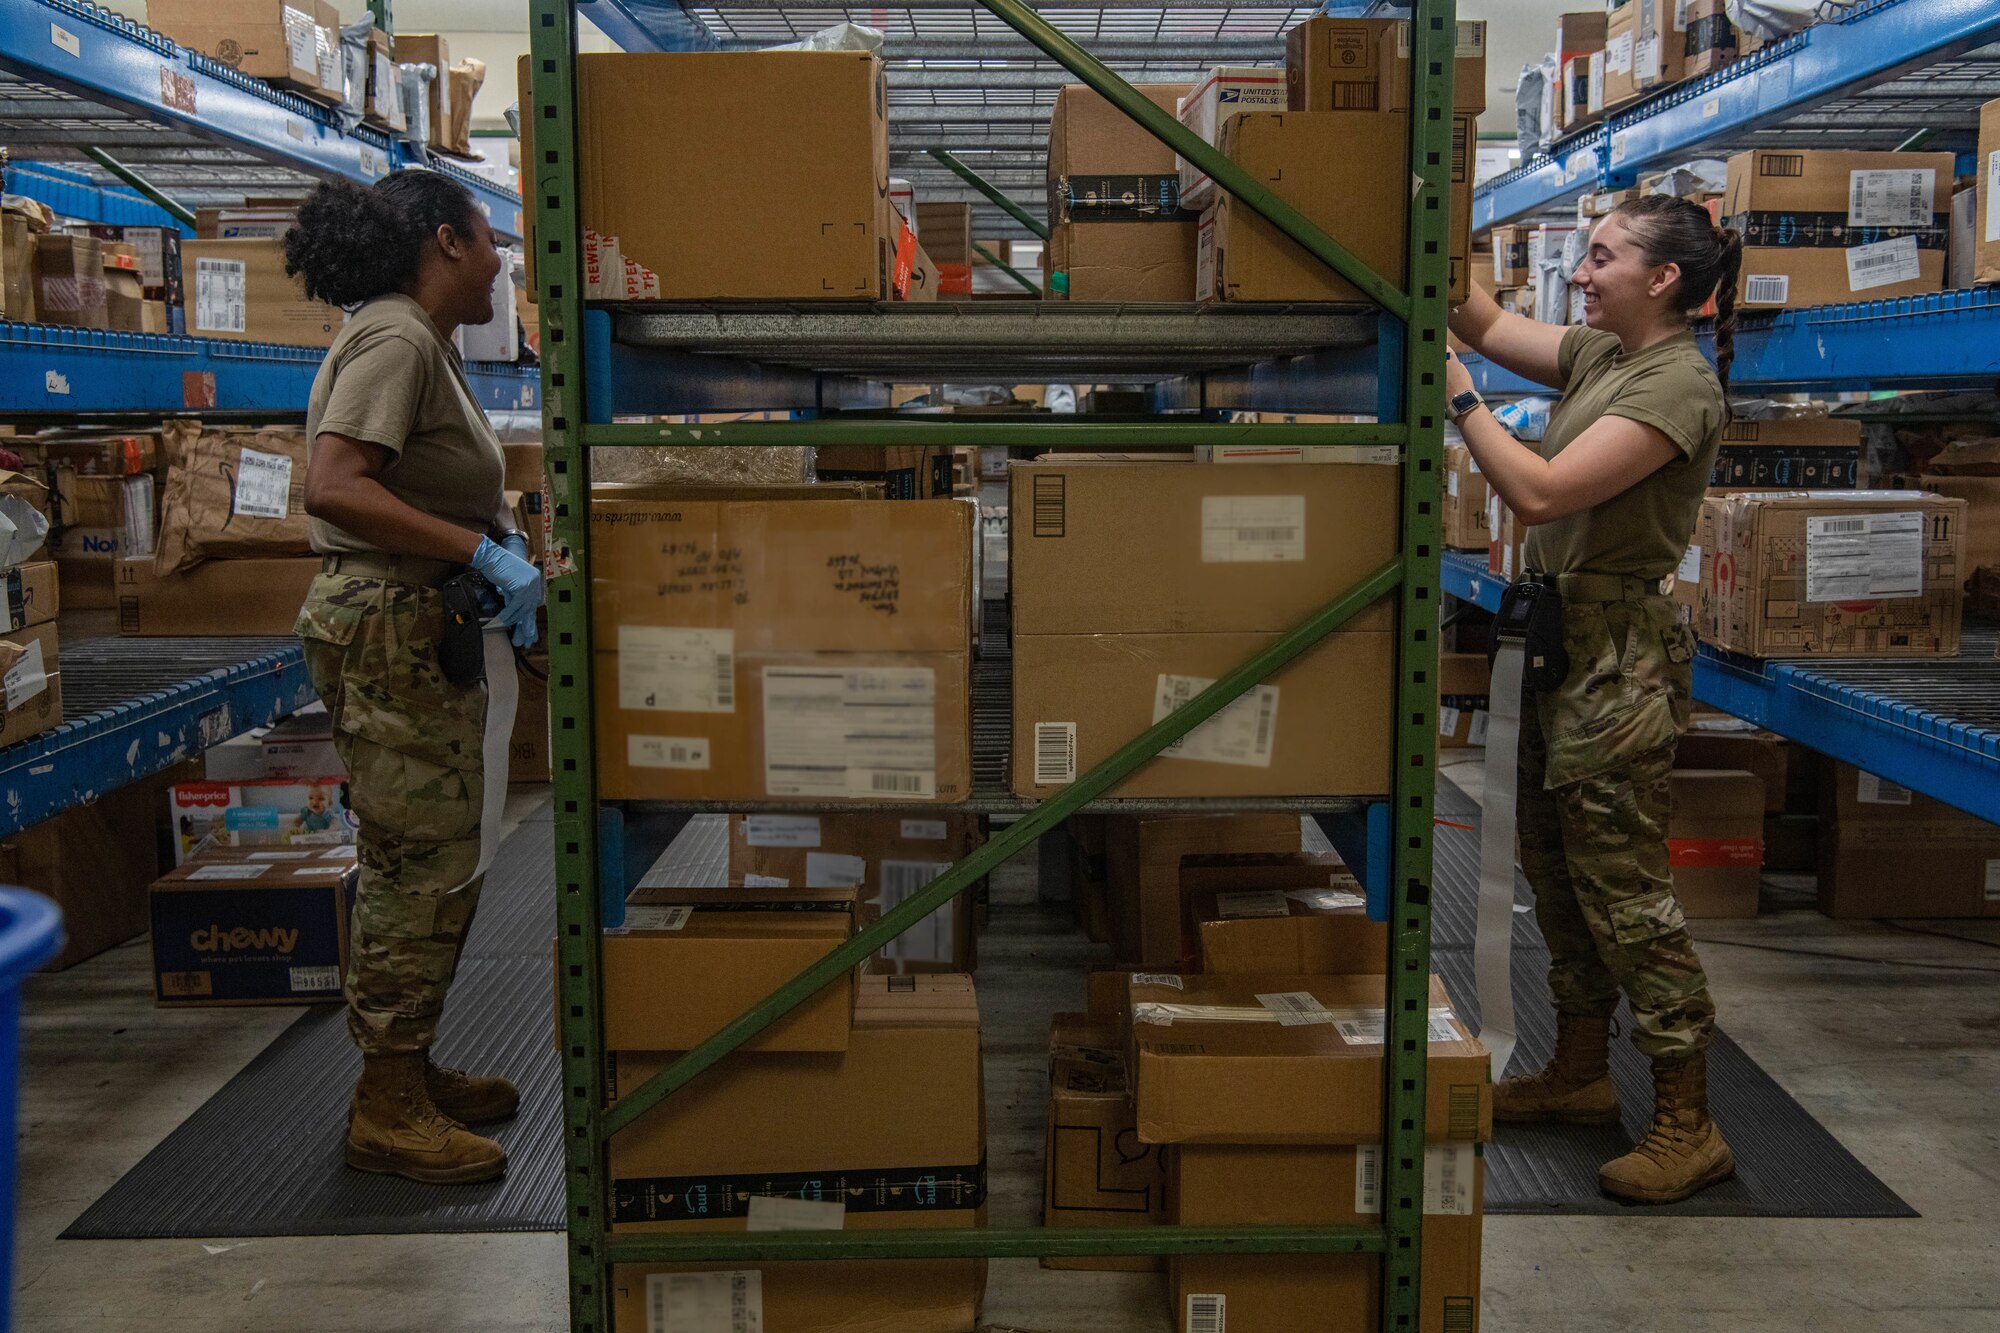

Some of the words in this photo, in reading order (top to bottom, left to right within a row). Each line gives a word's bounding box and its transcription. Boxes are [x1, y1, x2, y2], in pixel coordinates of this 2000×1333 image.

[1159, 179, 1169, 215] prime
[1778, 215, 1788, 245] prime
[1781, 457, 1791, 484] prime
[190, 923, 299, 954] chewy
